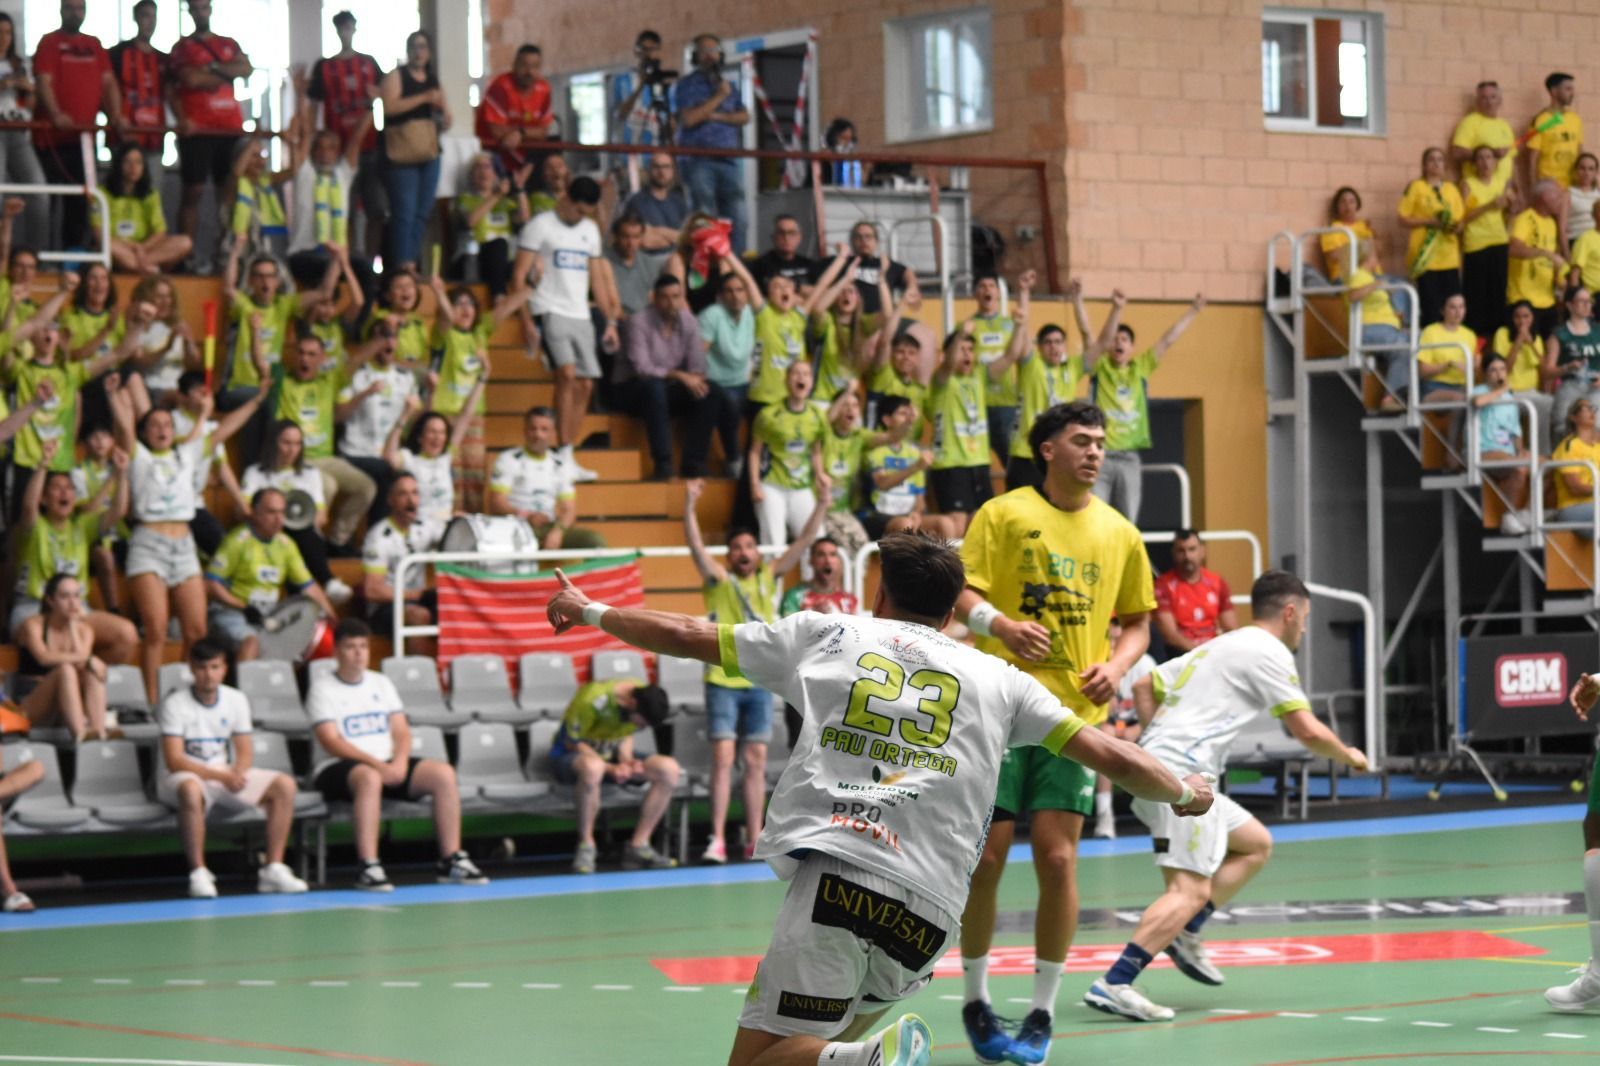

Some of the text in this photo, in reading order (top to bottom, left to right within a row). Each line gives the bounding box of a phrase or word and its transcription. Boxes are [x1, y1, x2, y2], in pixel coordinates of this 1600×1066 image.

[1048, 553, 1075, 579] 20
[1500, 658, 1561, 694] CBM
[843, 652, 960, 748] 23
[820, 726, 957, 777] PAU ORTEGA
[837, 782, 919, 800] MOLENDUM
[831, 801, 882, 823] PRO
